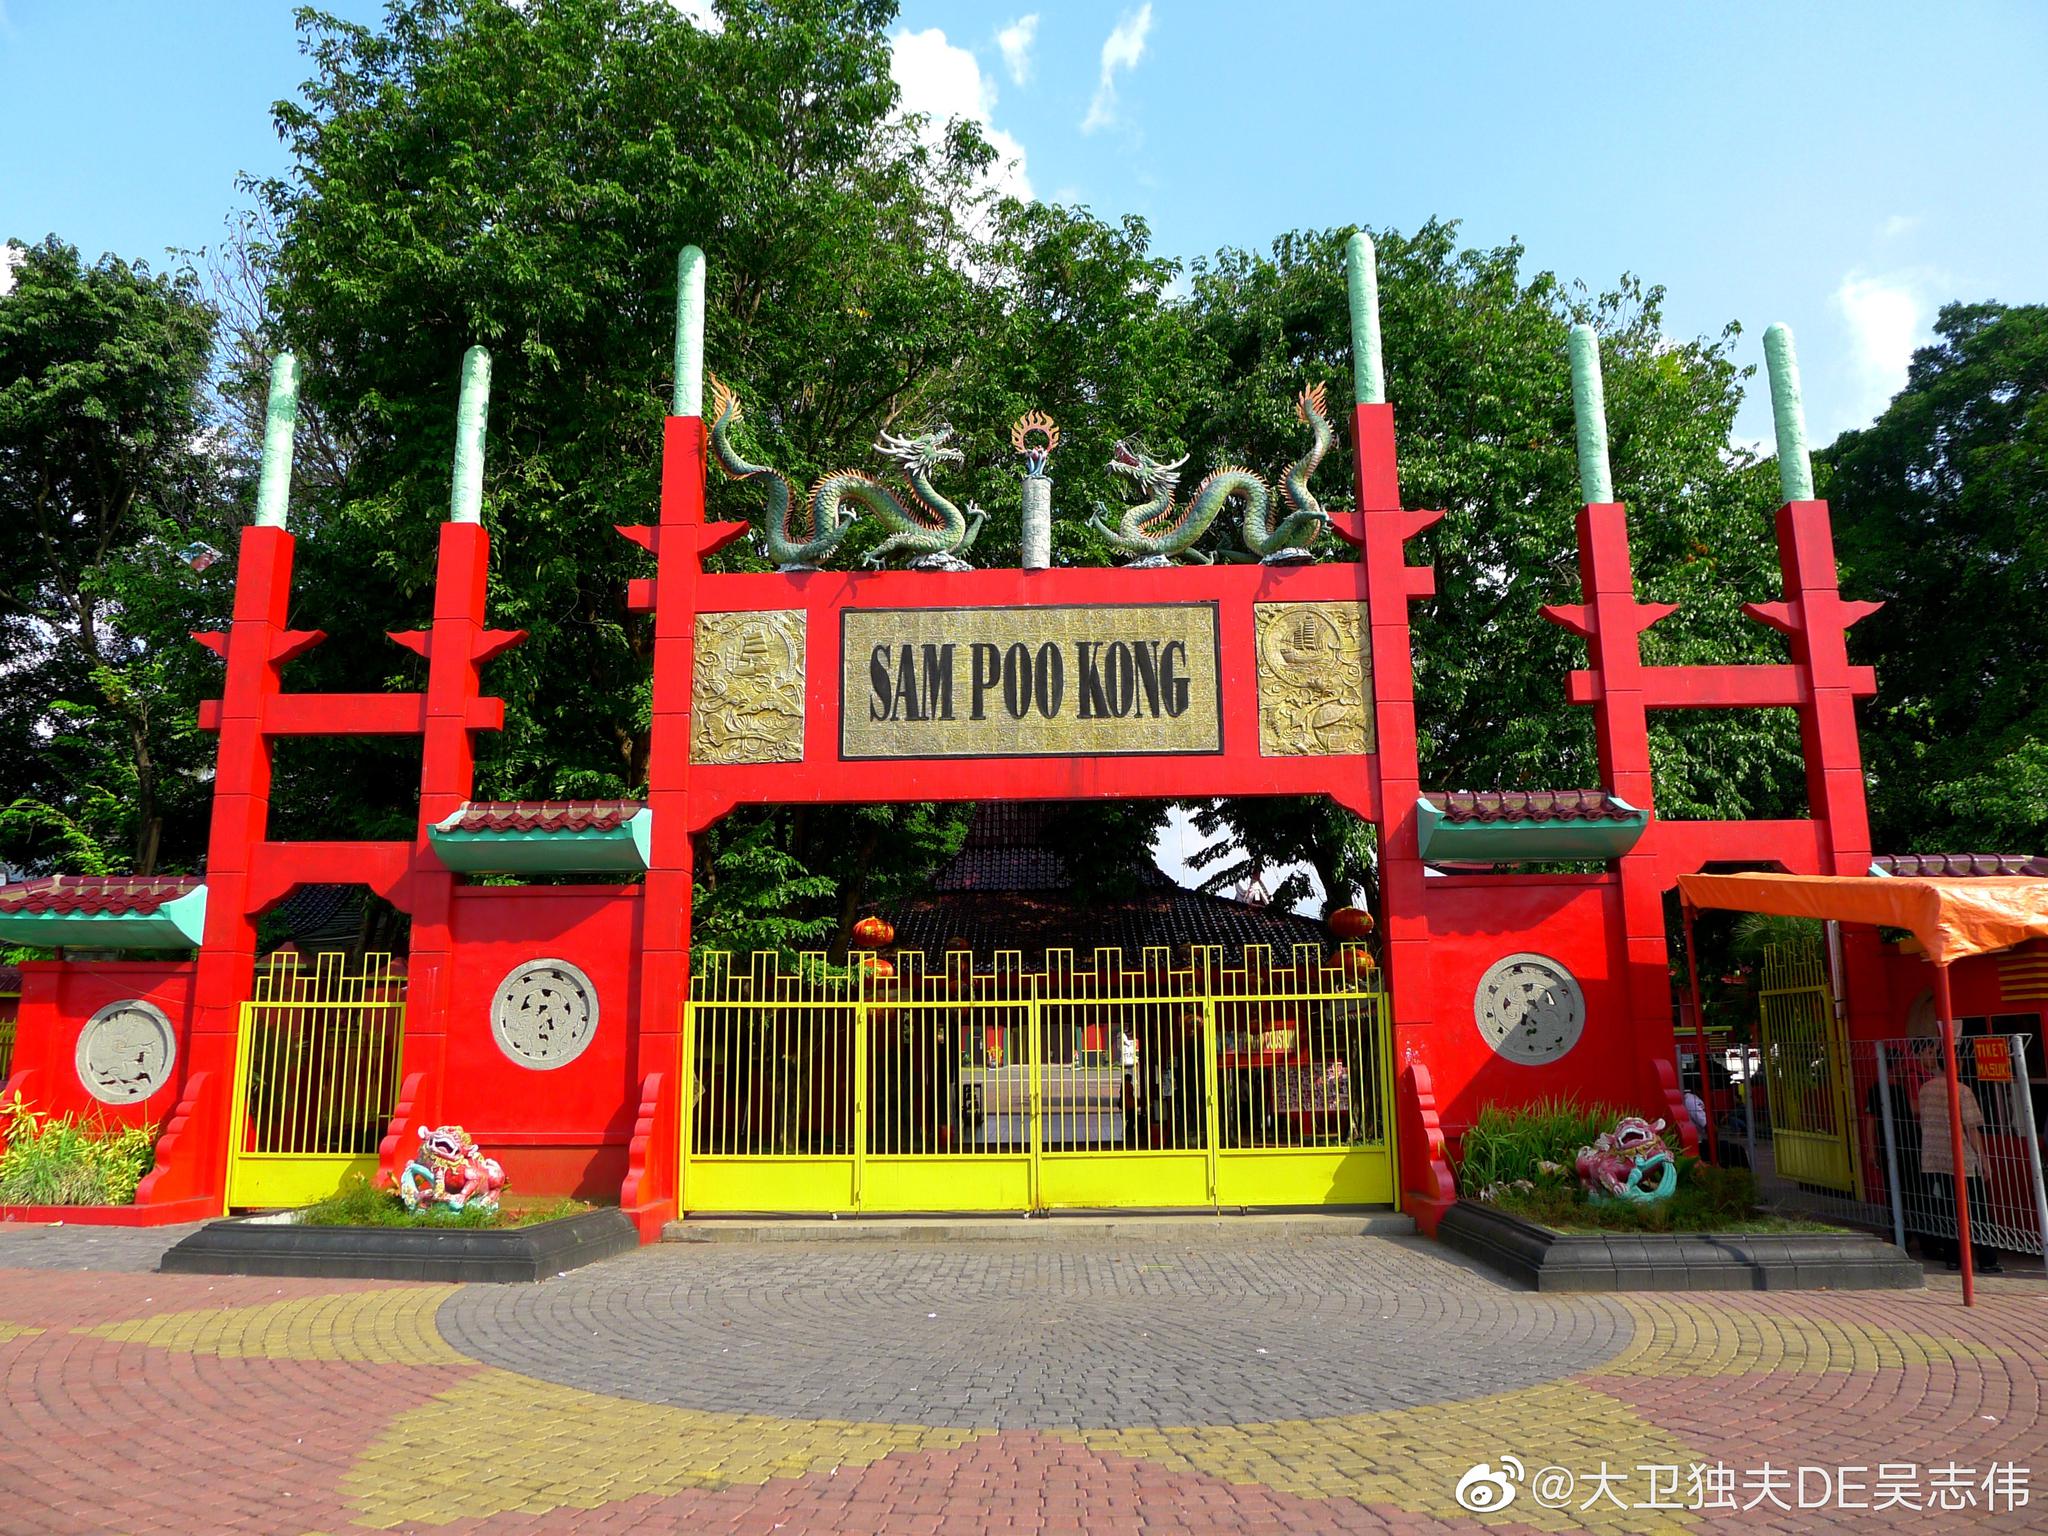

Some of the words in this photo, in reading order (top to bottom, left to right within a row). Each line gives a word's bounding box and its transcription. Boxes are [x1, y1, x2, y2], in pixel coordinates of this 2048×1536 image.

[870, 643, 956, 722] SAM
[969, 641, 1064, 721] POO
[1075, 640, 1191, 719] KONG
[1976, 1043, 2004, 1057] TIKET
[1977, 1063, 2007, 1076] MASUK
